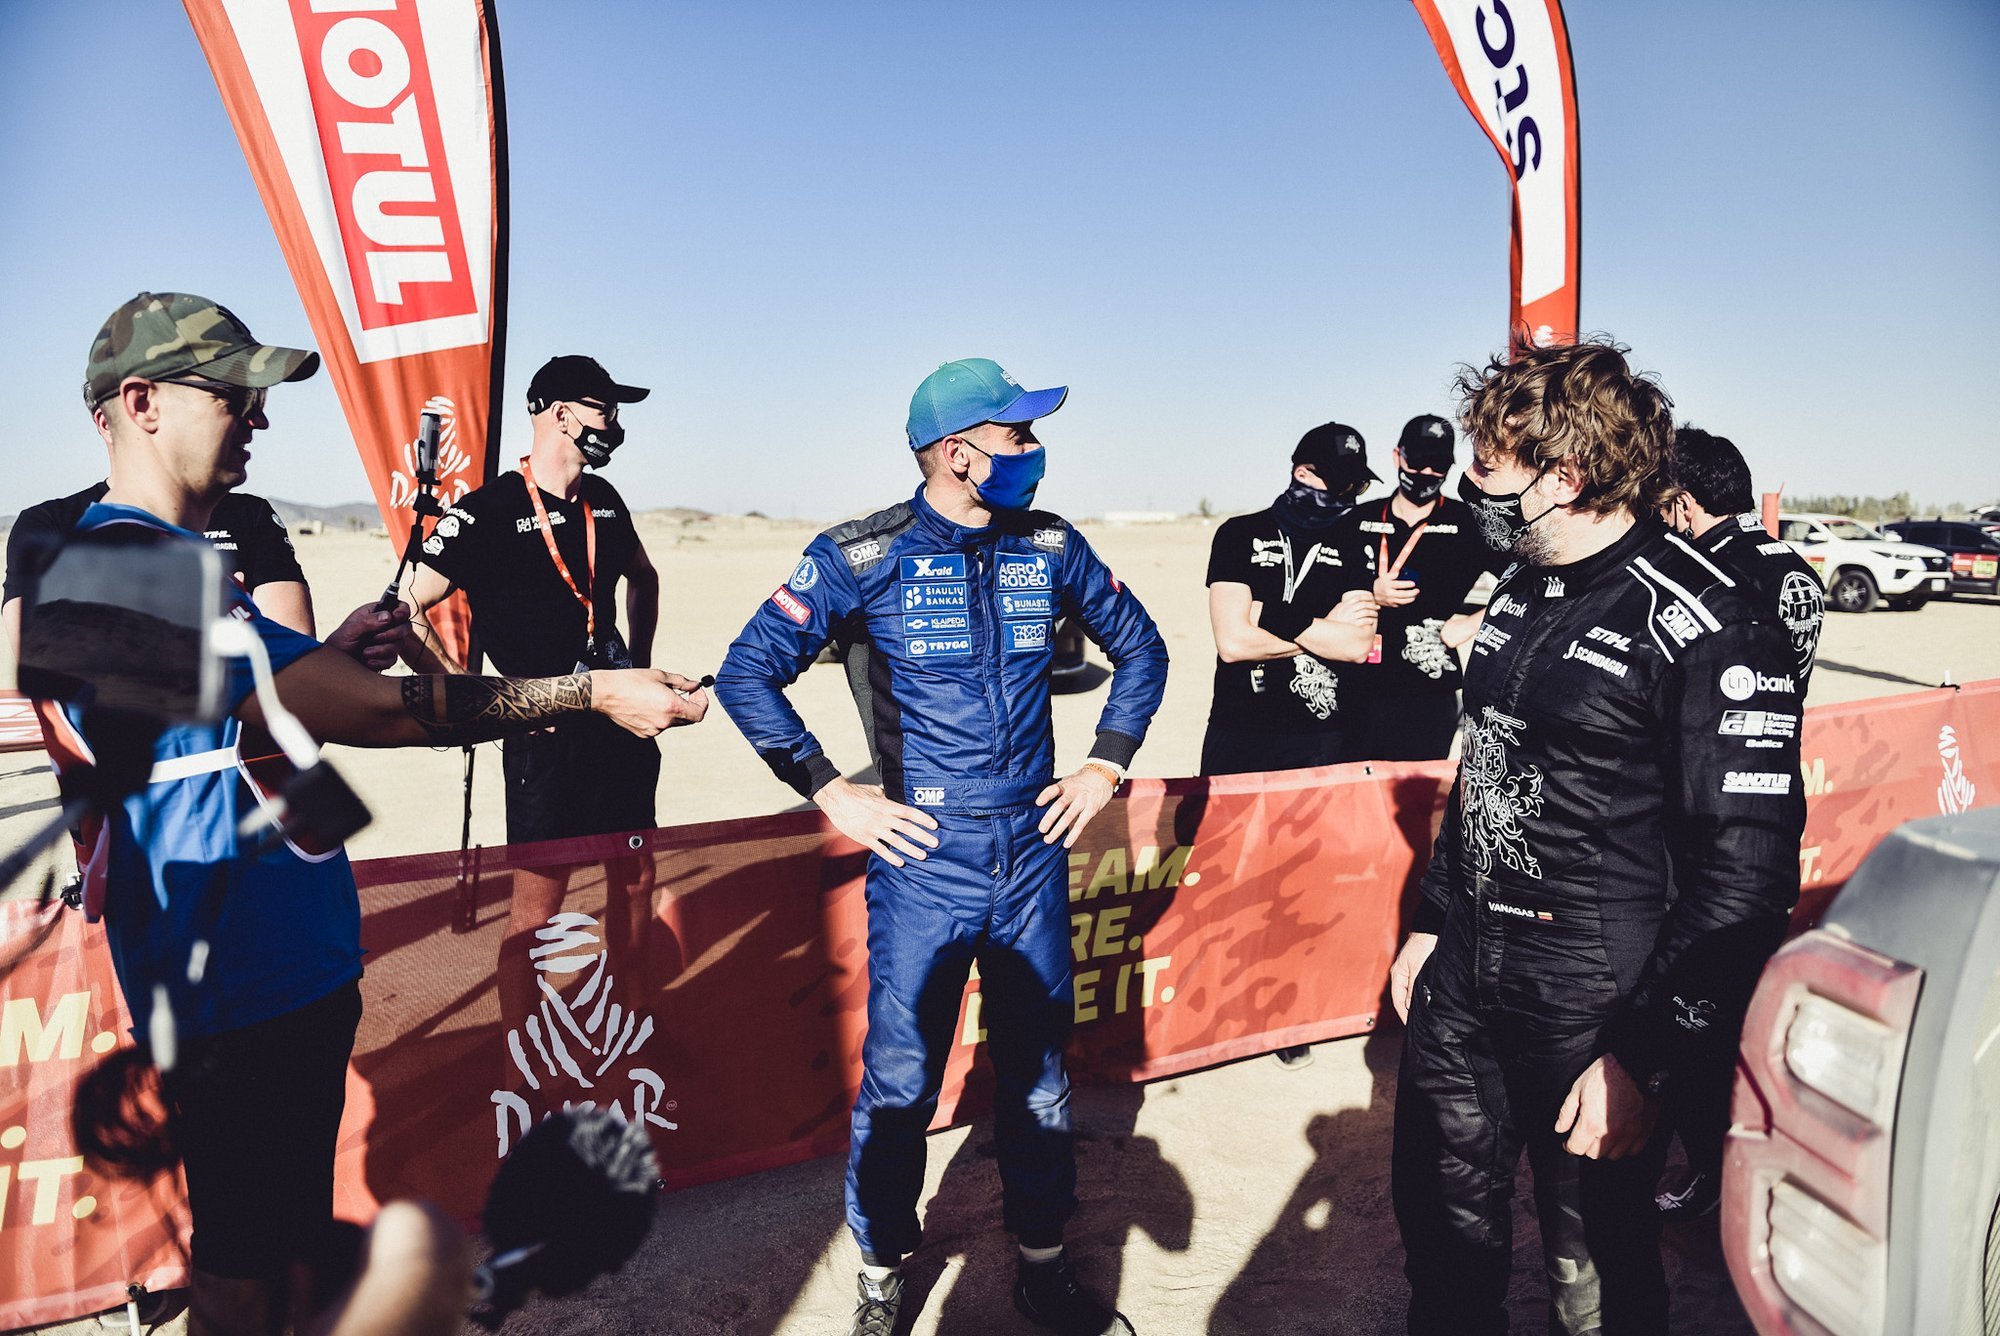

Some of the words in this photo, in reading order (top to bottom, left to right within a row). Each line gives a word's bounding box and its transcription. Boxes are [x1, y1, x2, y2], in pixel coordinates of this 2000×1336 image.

[309, 0, 453, 306] OTUL
[1034, 532, 1063, 545] OMP
[849, 542, 881, 562] OMP
[998, 562, 1037, 575] AGRO
[999, 573, 1048, 588] RODEO
[925, 586, 964, 596] ŠIAULIŲ
[773, 590, 807, 621] MOTUL
[926, 597, 965, 606] BANKAS
[1014, 599, 1050, 608] BUNASTA
[1662, 604, 1699, 641] OMP
[928, 640, 969, 651] TRYGG
[1585, 626, 1632, 653] STIHL
[1574, 646, 1629, 678] SCANDAGRA
[914, 789, 945, 803] OMP
[1067, 845, 1201, 903] EAM.
[1488, 901, 1536, 918] VANAGAS
[1070, 904, 1143, 963] RE.
[1115, 955, 1176, 1015] IT.
